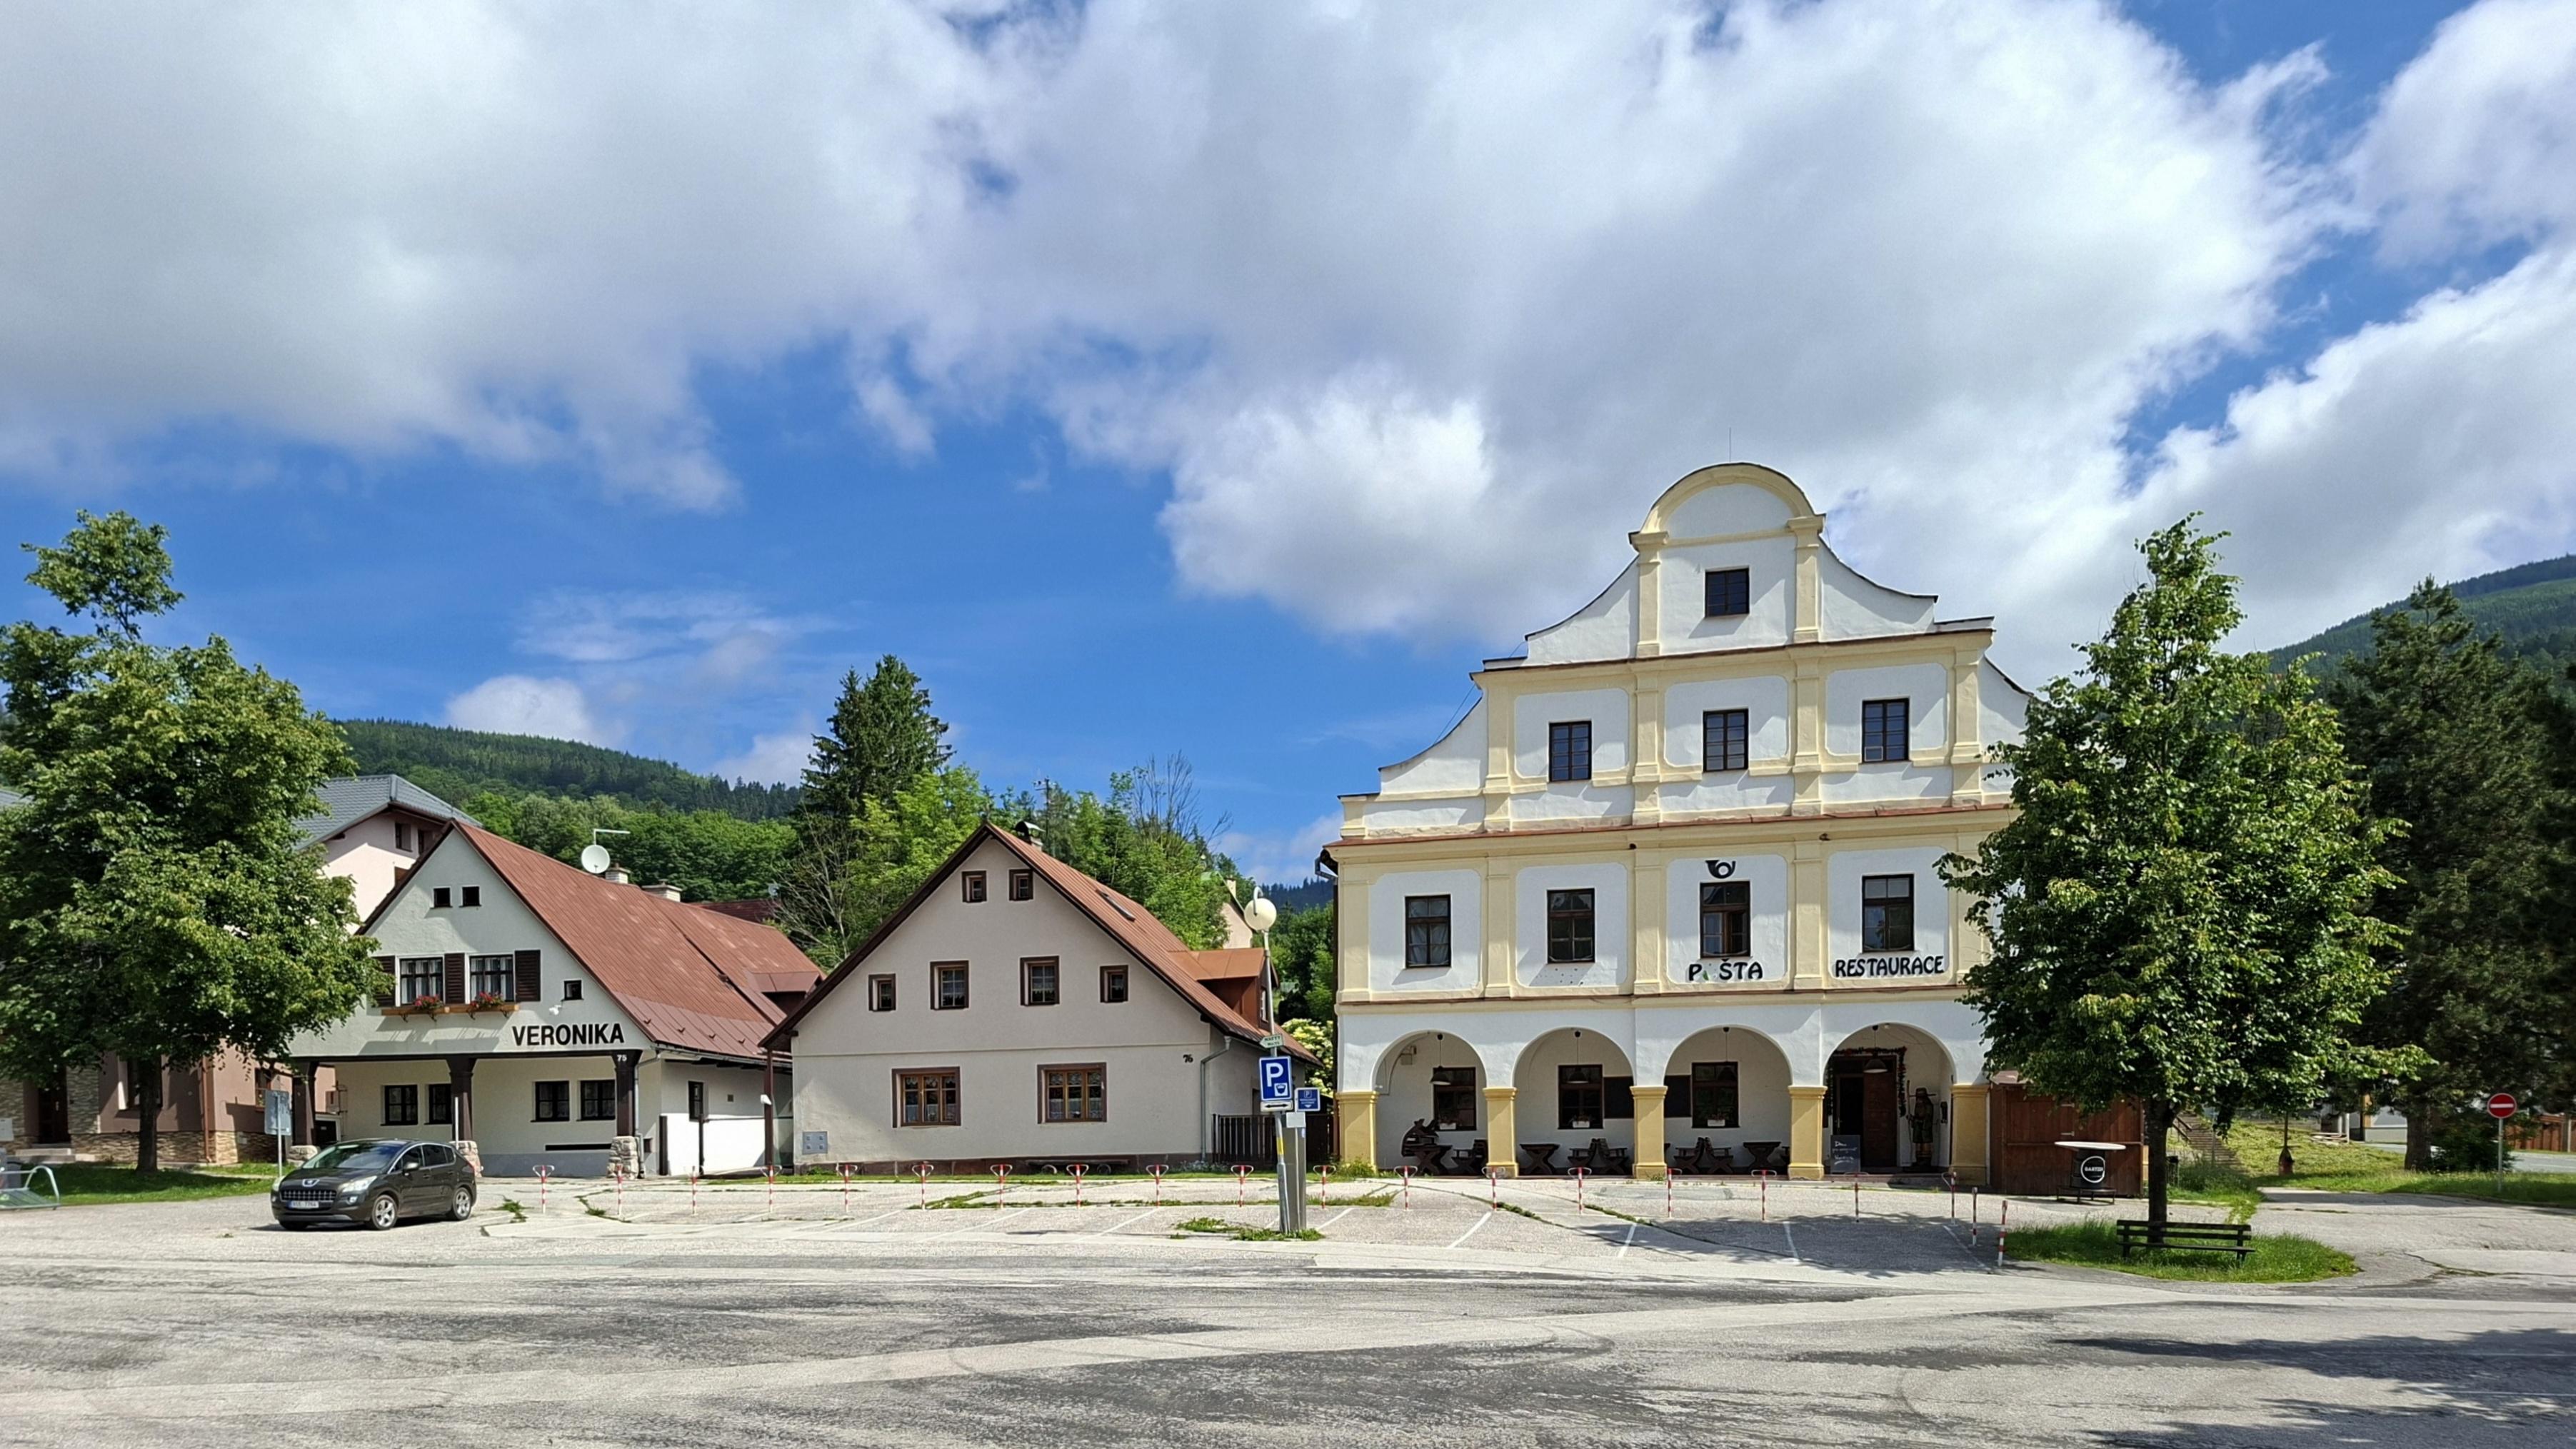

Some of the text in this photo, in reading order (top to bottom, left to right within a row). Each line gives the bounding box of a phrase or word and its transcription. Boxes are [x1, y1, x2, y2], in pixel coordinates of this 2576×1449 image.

[1835, 956, 1944, 977] RESTAURACE
[511, 1023, 625, 1046] VERONIKA
[1183, 1054, 1193, 1063] 76
[1266, 1063, 1284, 1087] P
